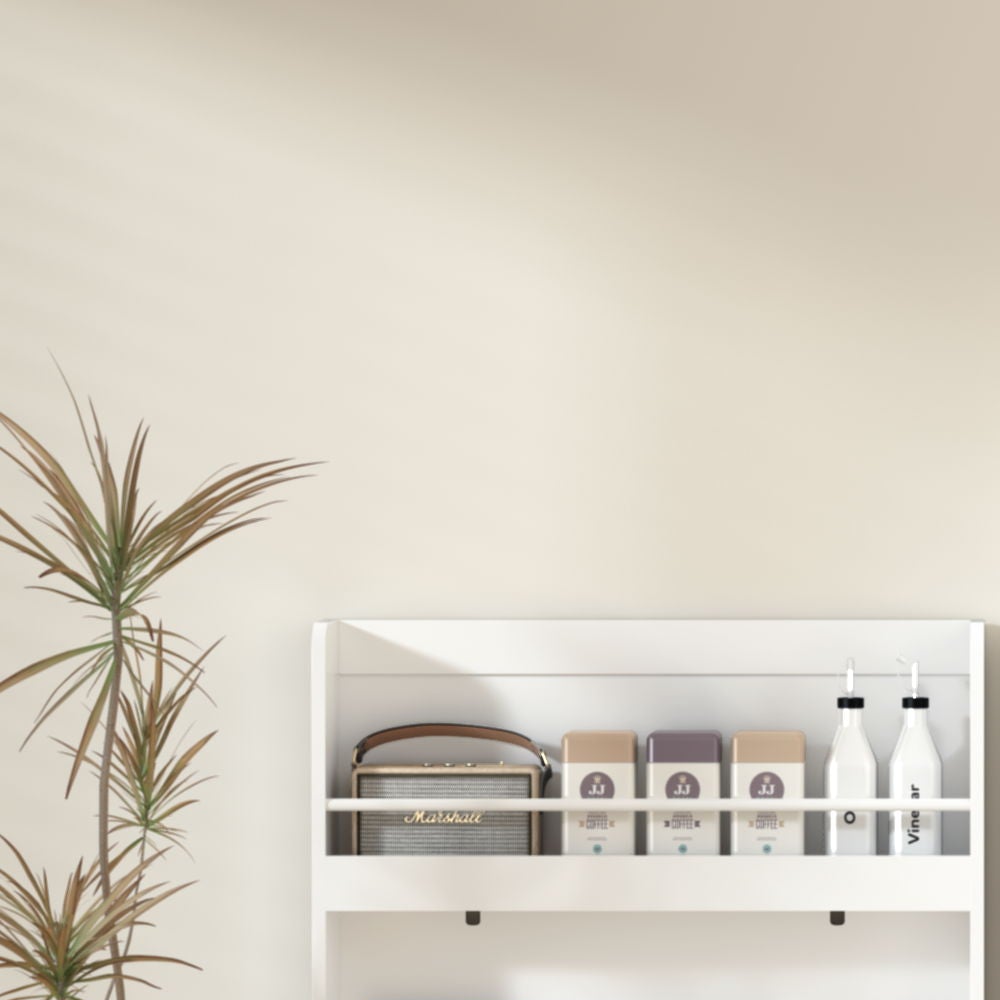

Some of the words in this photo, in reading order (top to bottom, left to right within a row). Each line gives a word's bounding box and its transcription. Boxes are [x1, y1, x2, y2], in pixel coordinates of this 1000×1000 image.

[588, 784, 605, 796] JJ
[673, 784, 691, 796] JJ
[757, 784, 775, 796] JJ
[907, 784, 920, 845] Vinear
